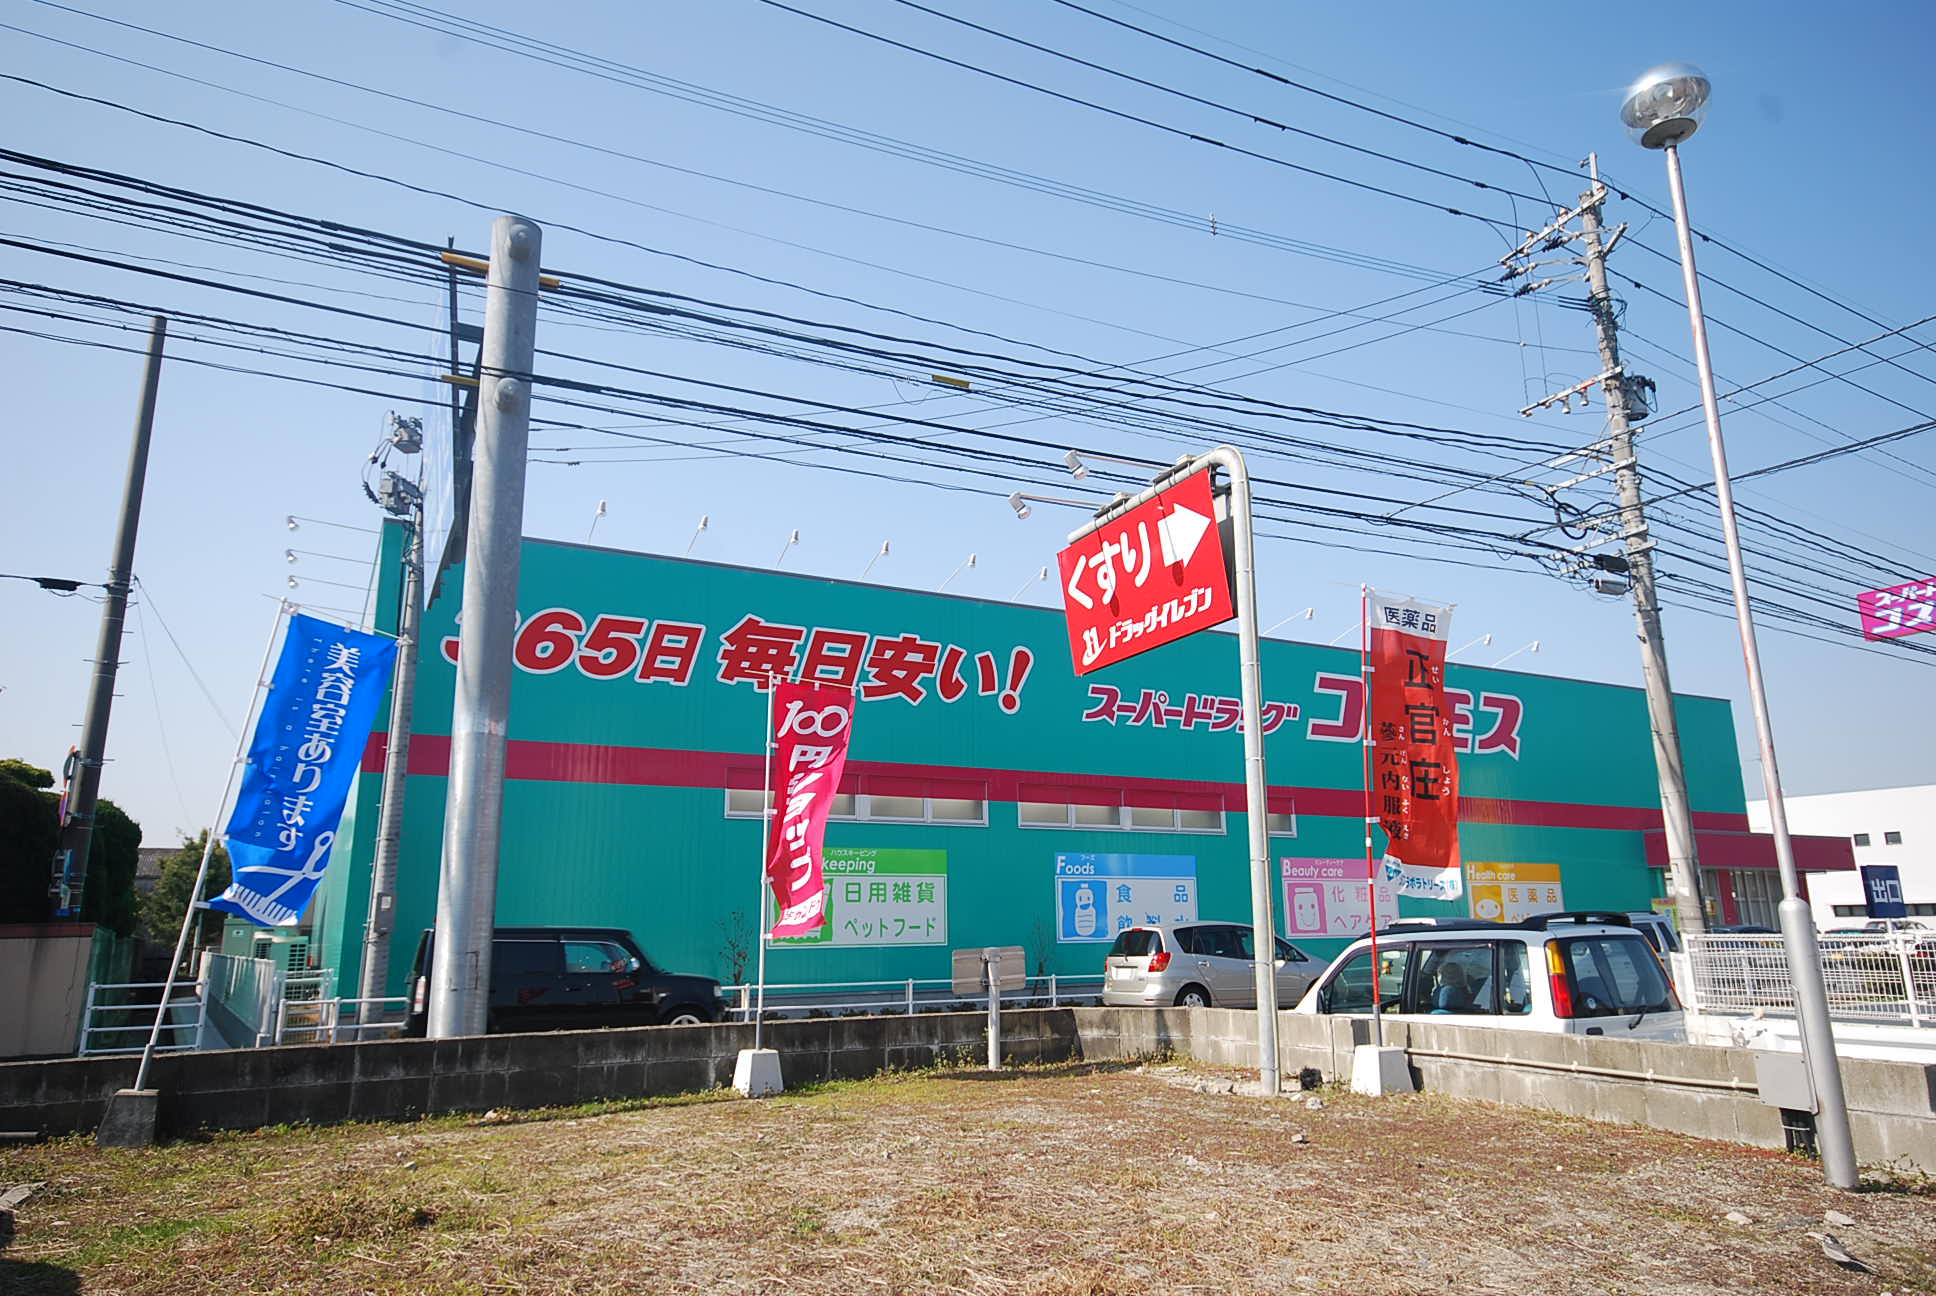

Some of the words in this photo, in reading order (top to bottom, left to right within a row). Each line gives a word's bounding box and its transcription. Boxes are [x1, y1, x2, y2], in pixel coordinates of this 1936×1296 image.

[1067, 521, 1151, 609] くすり
[1109, 586, 1212, 649] ドラッグイレブン
[1384, 606, 1437, 633] 医薬品
[1082, 684, 1300, 735] スーパードラグ
[1403, 649, 1441, 800] 正官庄
[276, 641, 361, 852] 美容室あります
[822, 858, 876, 873] keeping
[1056, 855, 1095, 875] Foods
[1282, 859, 1319, 878] Beauty
[1321, 868, 1344, 877] care
[845, 882, 935, 904] 日用雑貨
[1116, 884, 1189, 903] 食品
[1332, 885, 1392, 903] 化粧品
[1871, 878, 1901, 903] 出口
[844, 917, 936, 938] ペットフード
